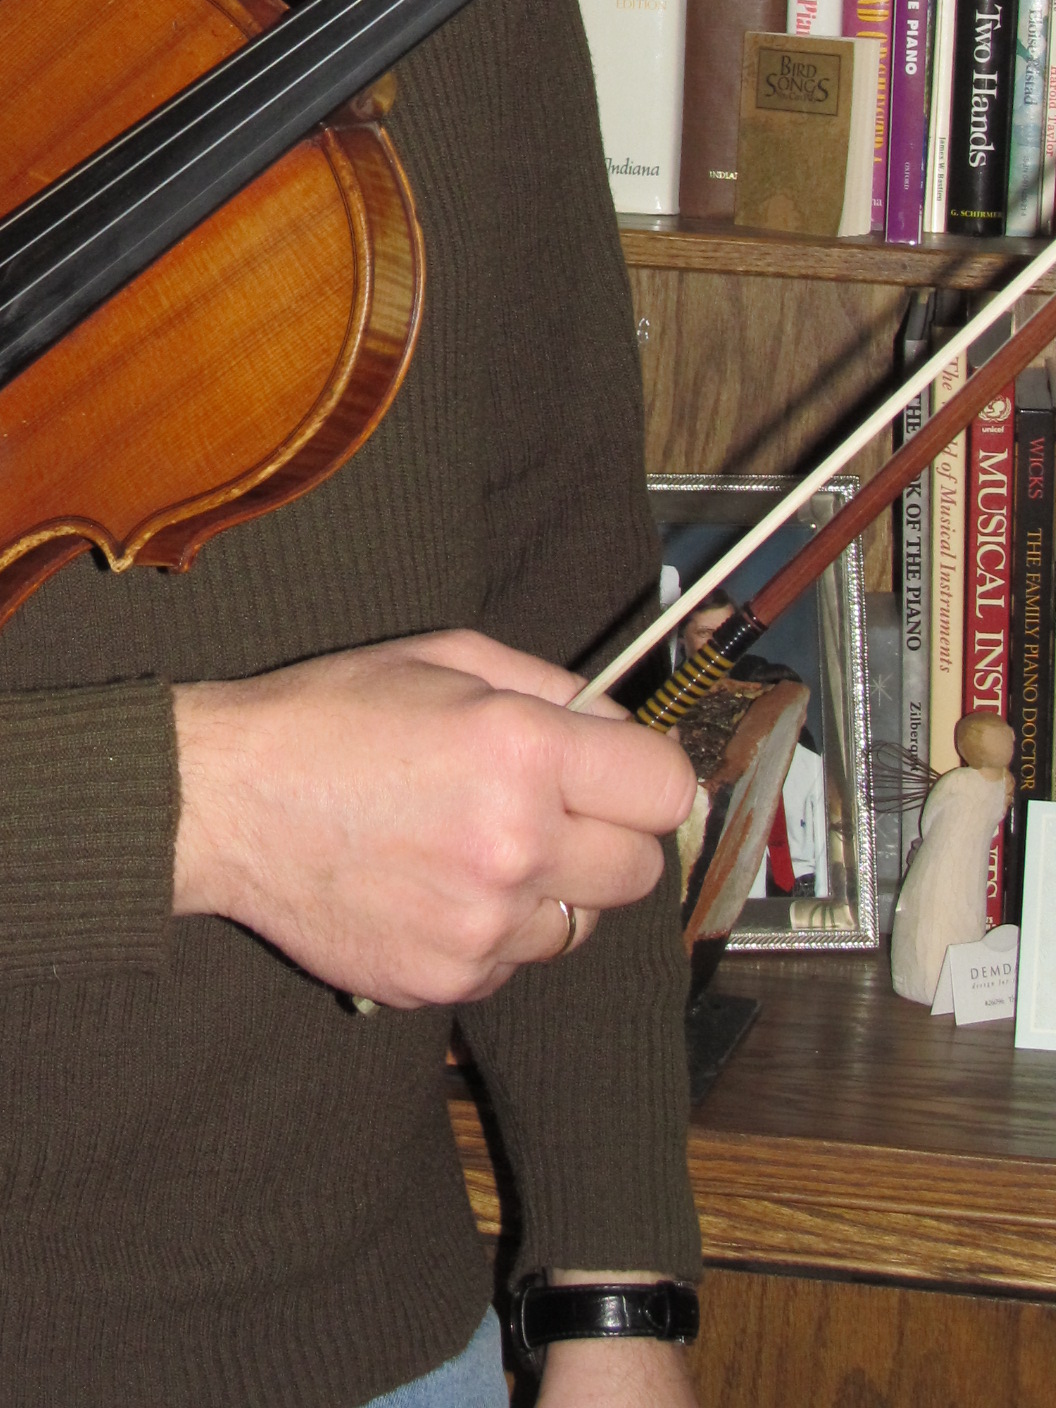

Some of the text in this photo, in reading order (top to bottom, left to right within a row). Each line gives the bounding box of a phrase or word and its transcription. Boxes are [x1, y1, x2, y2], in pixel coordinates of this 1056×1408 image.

[905, 19, 920, 75] PIANO
[973, 3, 1003, 64] Two
[1027, 8, 1043, 55] Eloise
[765, 73, 831, 103] SONGS
[780, 54, 818, 78] BIRD
[968, 69, 999, 168] Hands
[604, 156, 660, 177] Indiana
[938, 136, 946, 160] James
[936, 173, 944, 202] Bastien
[950, 209, 959, 217] G.
[941, 356, 960, 391] The
[936, 461, 957, 484] of
[1028, 437, 1045, 500] WICKS
[905, 503, 922, 532] OF
[939, 484, 957, 560] Musical
[905, 536, 922, 582] THE
[972, 448, 1009, 716] MUSICAL INST
[905, 586, 922, 652] PIANO
[938, 563, 956, 673] Instruments
[1020, 527, 1042, 790] THE FAMILY PIANO DOCTOR
[970, 963, 1012, 980] DEMD
